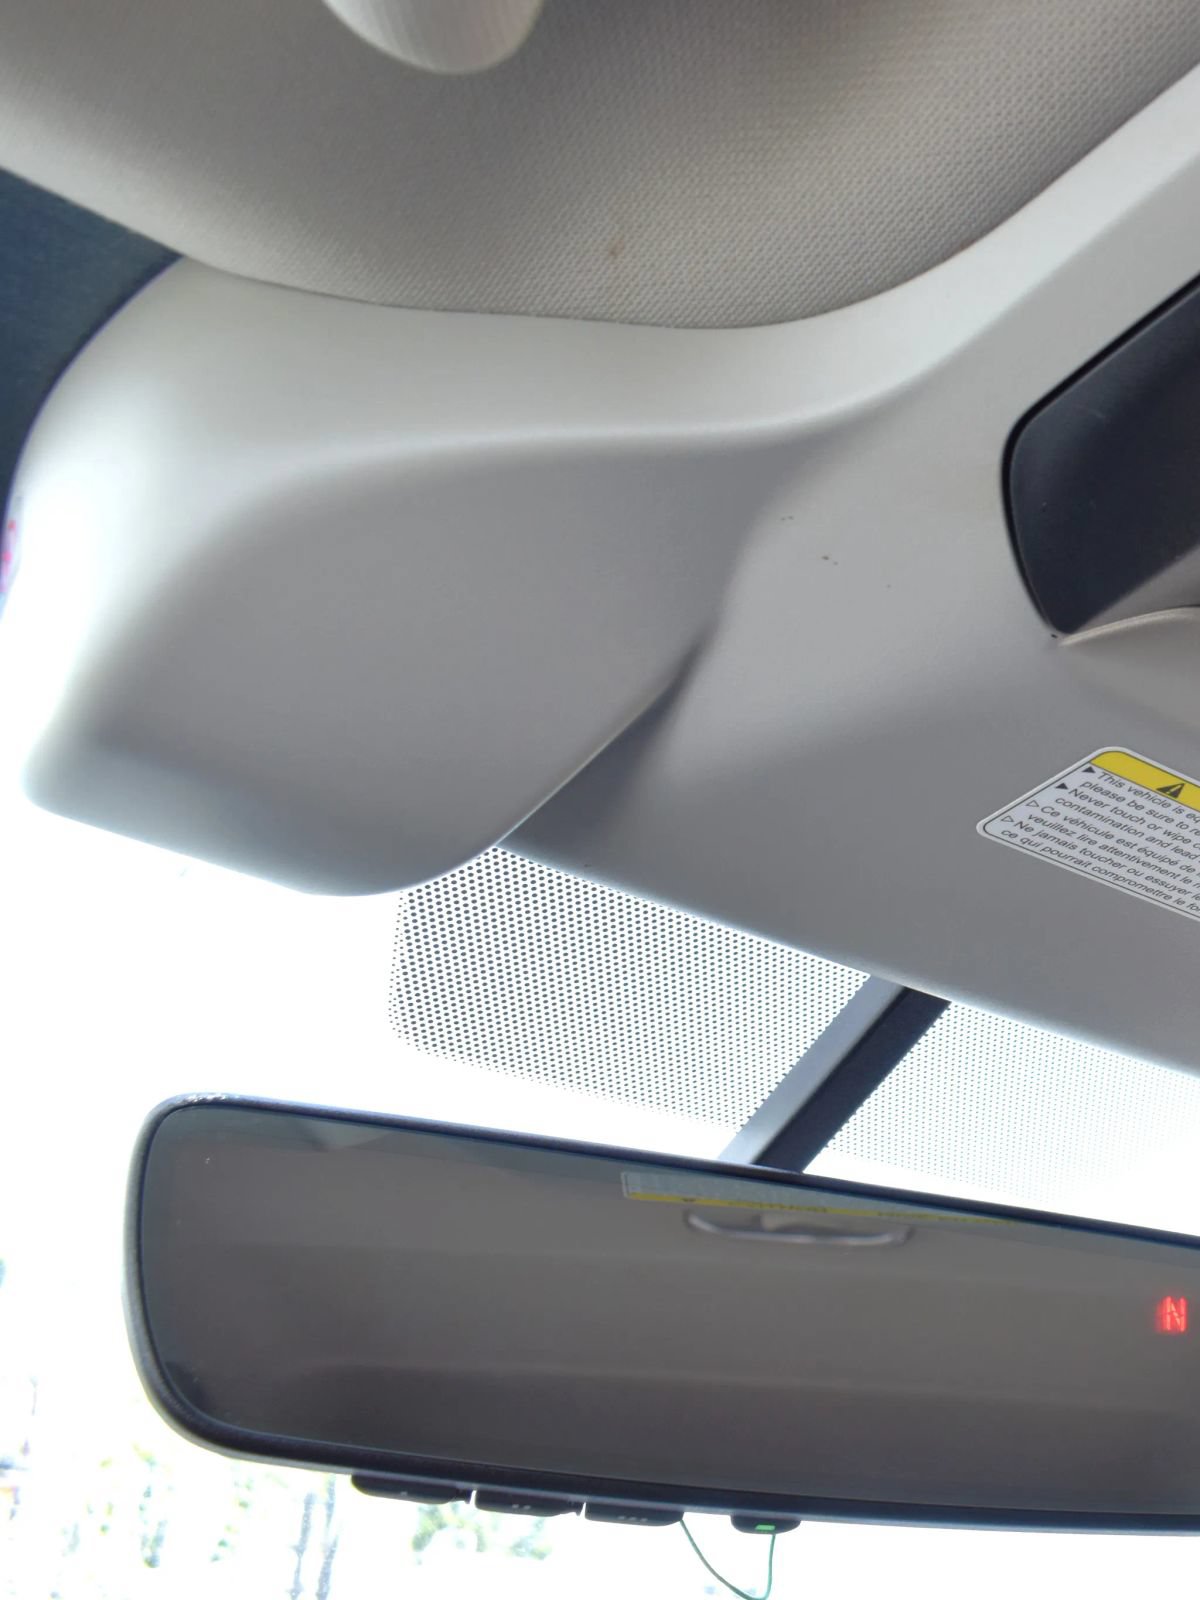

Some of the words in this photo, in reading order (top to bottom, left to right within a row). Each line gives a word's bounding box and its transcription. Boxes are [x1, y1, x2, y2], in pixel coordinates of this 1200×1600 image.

[1067, 788, 1112, 809] Never
[1109, 806, 1147, 826] touch
[1146, 823, 1164, 831] or
[1162, 829, 1192, 845] wipe
[1078, 781, 1127, 803] please
[1126, 799, 1145, 811] be
[1145, 808, 1175, 824] sure
[1175, 821, 1190, 830] to
[1097, 771, 1126, 789] This
[1127, 785, 1172, 809] vehicle
[1171, 805, 1185, 815] is
[1027, 814, 1077, 838] veuillez
[1076, 833, 1098, 846] lire
[1097, 844, 1182, 880] attentivement
[1179, 876, 1193, 885] le
[1040, 805, 1061, 818] Ce
[1115, 838, 1139, 850] est
[1136, 846, 1181, 866] équipé
[1178, 864, 1196, 874] de
[1054, 797, 1145, 838] contamination
[1144, 836, 1174, 849] and
[1000, 830, 1019, 839] ce
[1019, 837, 1044, 848] qui
[1041, 846, 1092, 867] pourrait
[1091, 865, 1172, 900] compromettre
[1172, 897, 1186, 906] le
[1012, 820, 1035, 833] Ne
[1031, 829, 1079, 851] jamais
[1078, 847, 1128, 870] toucher
[1126, 867, 1145, 877] ou
[1144, 875, 1193, 896] essuyer
[1162, 1295, 1187, 1333] N
